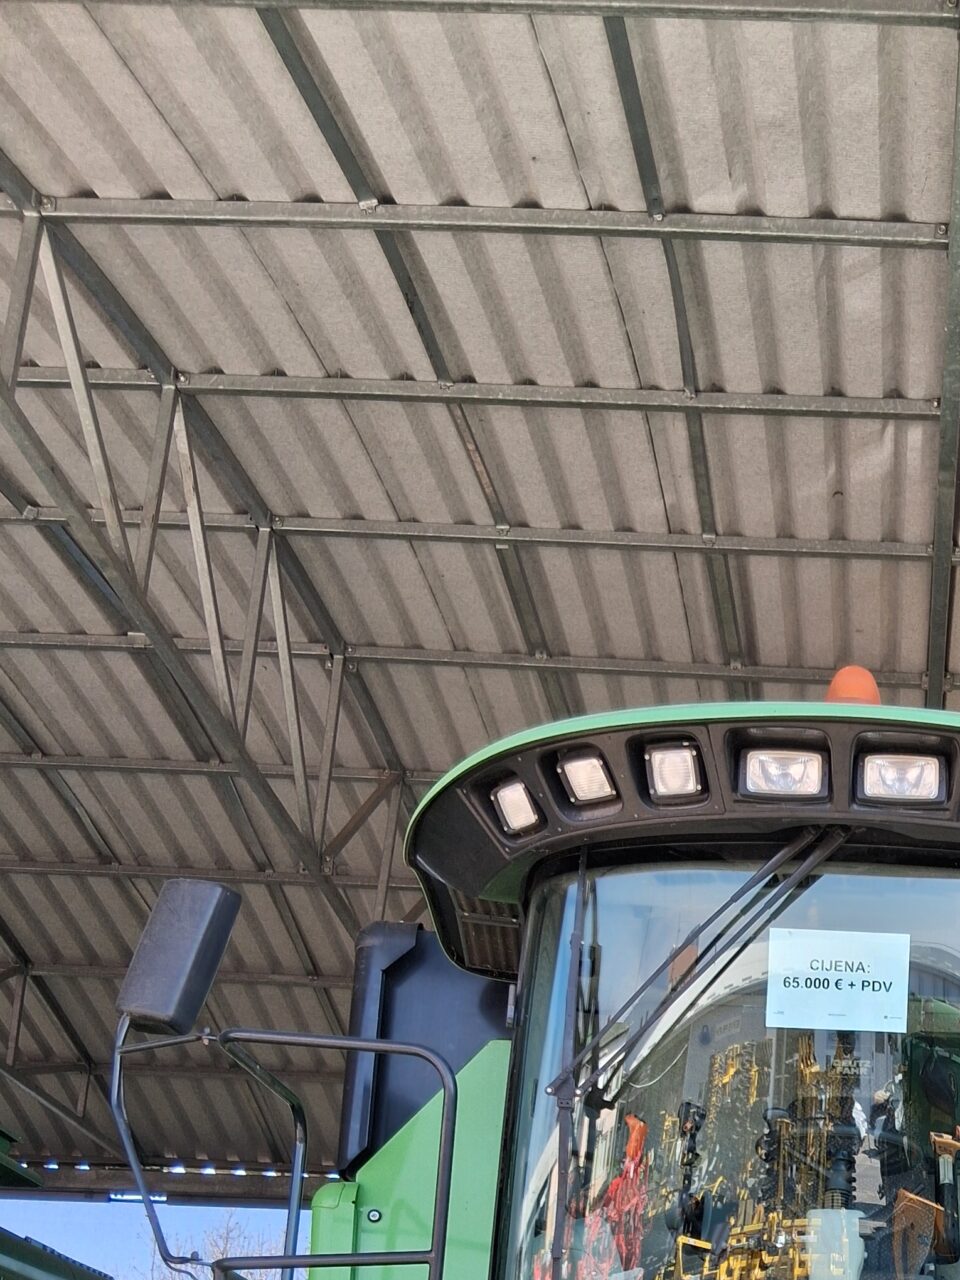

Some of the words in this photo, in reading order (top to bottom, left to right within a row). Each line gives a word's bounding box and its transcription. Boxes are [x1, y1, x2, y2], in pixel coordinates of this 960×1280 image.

[809, 959, 871, 974] CIJENA:
[783, 976, 831, 990] 65.000
[834, 978, 844, 991] €
[848, 981, 856, 989] +
[861, 980, 893, 993] PDV
